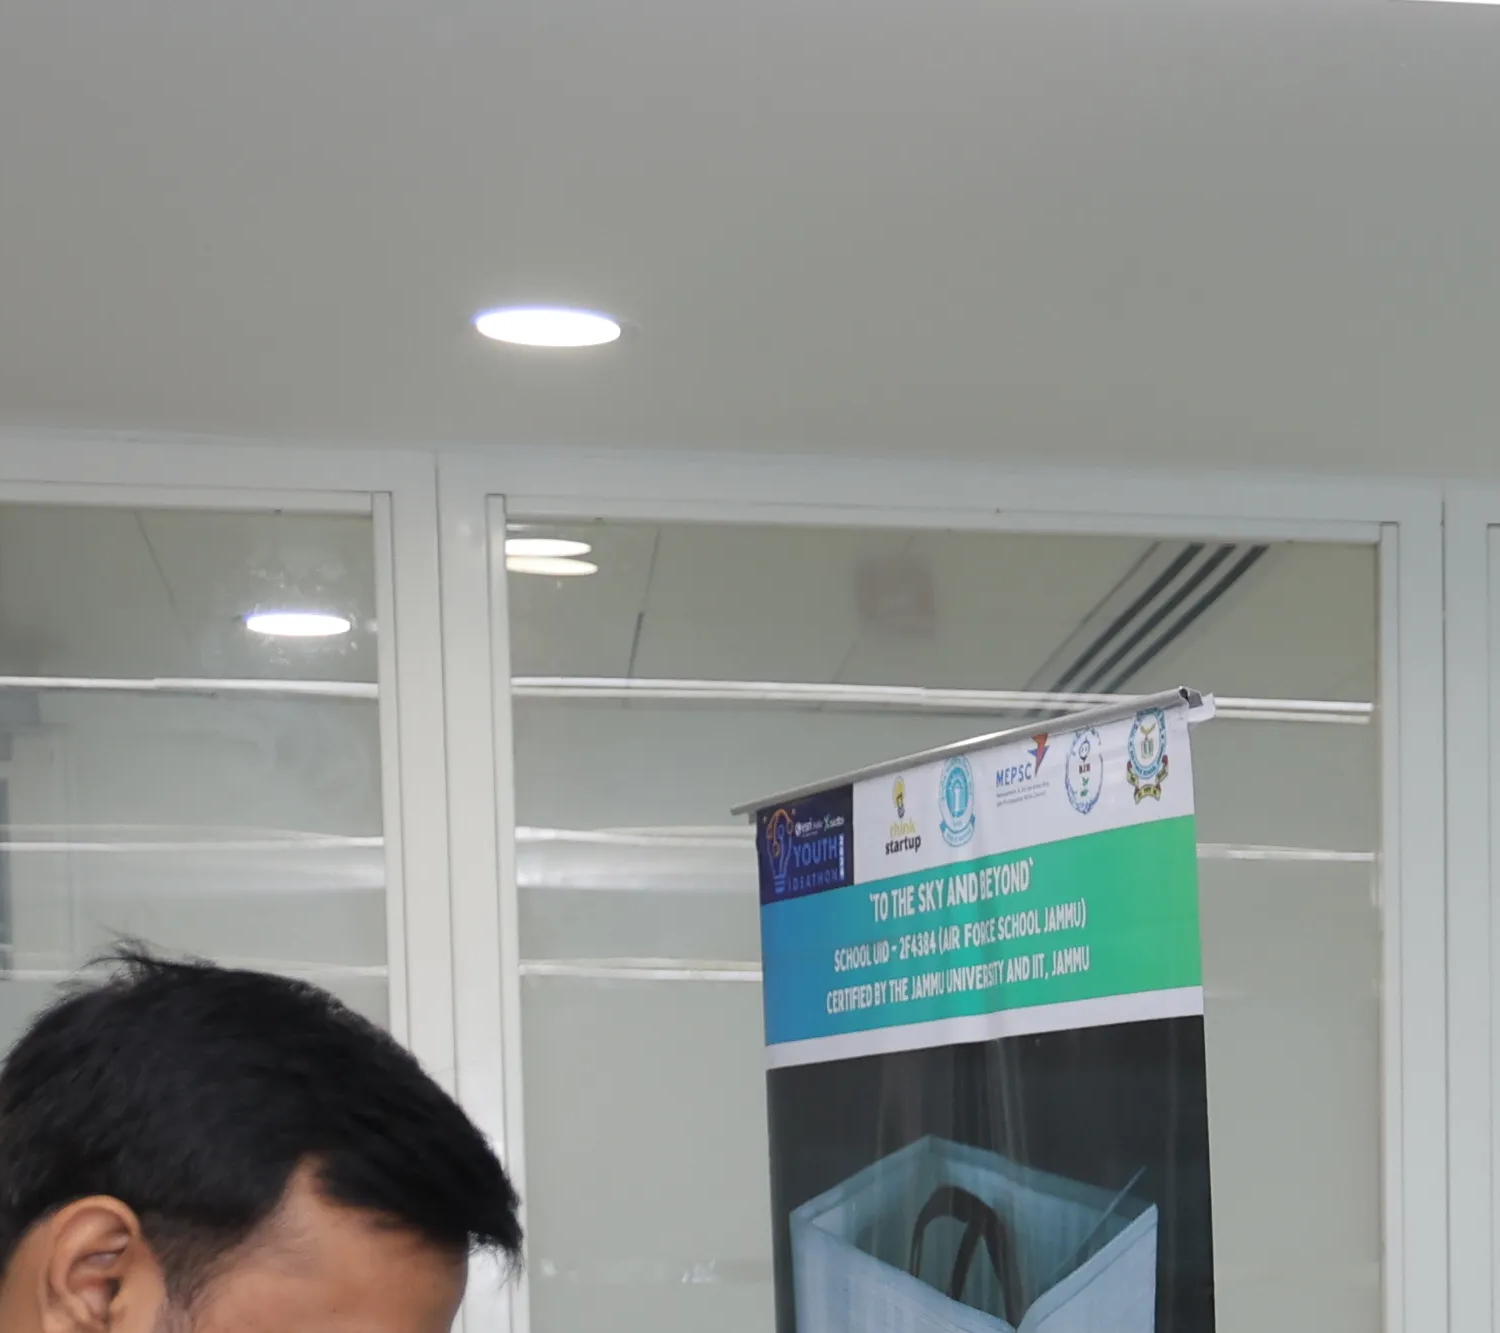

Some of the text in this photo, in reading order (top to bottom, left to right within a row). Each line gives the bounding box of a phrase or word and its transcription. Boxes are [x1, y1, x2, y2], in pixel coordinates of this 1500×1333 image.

[996, 763, 1032, 787] MEPSC
[793, 836, 838, 868] YOUTH
[885, 834, 922, 855] startup
[788, 868, 839, 892] IDEATHON
[891, 884, 915, 920] THE
[918, 878, 944, 913] SKY
[947, 872, 978, 907] AND
[834, 946, 872, 973] SCHOOL
[873, 940, 889, 965] UID
[939, 924, 960, 956] (AIR
[964, 919, 996, 949] FORCE
[998, 908, 1041, 941] SCHOOL
[1044, 898, 1087, 932] JAMMU)
[826, 989, 873, 1015] CERTIFIED
[874, 982, 887, 1005] BY
[889, 976, 908, 1003] THE
[911, 969, 944, 1000] JAMMU
[946, 956, 1003, 993] UNIVERSITY
[1006, 953, 1030, 984] AND
[1051, 946, 1090, 977] JAMMU
